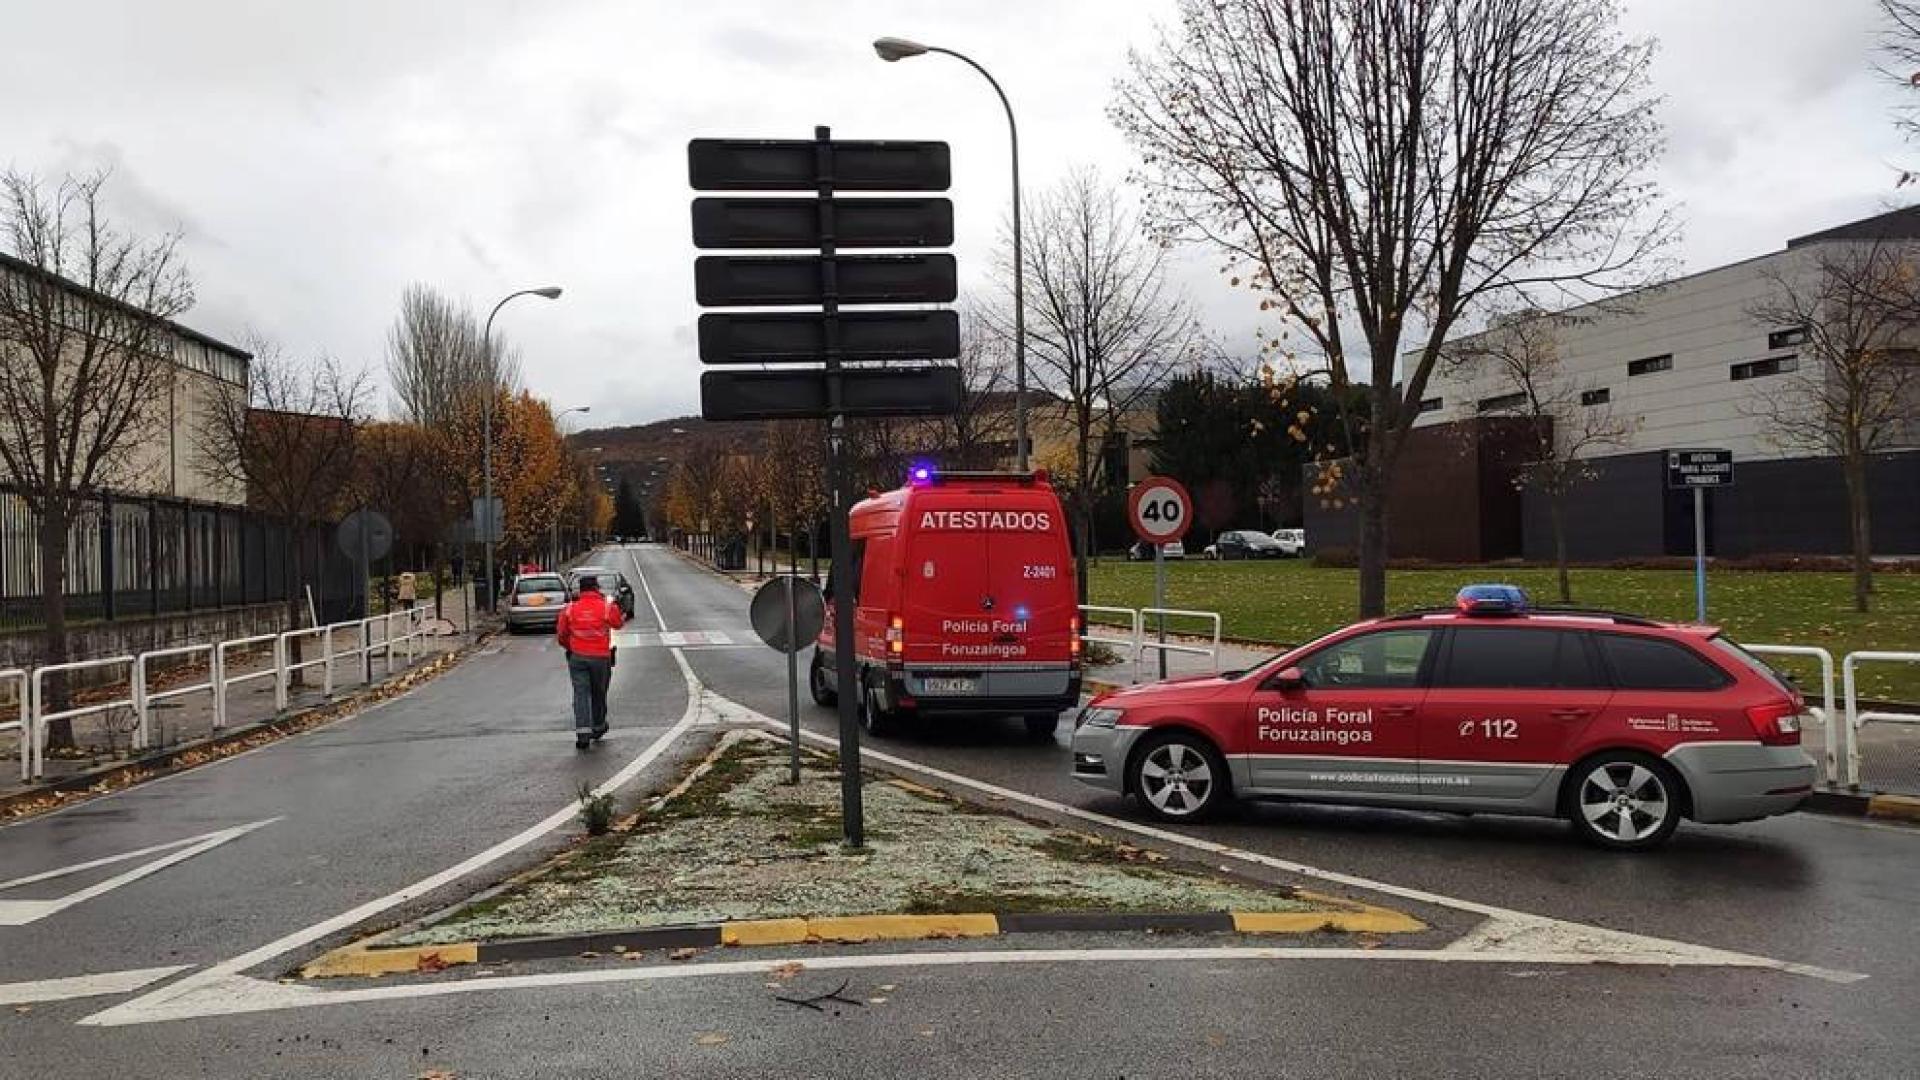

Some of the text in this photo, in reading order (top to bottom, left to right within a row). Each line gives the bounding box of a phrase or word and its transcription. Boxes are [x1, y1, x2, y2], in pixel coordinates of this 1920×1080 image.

[920, 511, 1050, 530] ATESTADOS
[1143, 500, 1179, 522] 40
[943, 620, 1027, 633] Policía Foral
[942, 643, 1026, 657] Foruzaingoa
[1258, 707, 1372, 724] Policía Foral
[1258, 725, 1372, 745] Foruzaingoa
[1481, 719, 1519, 738] 112
